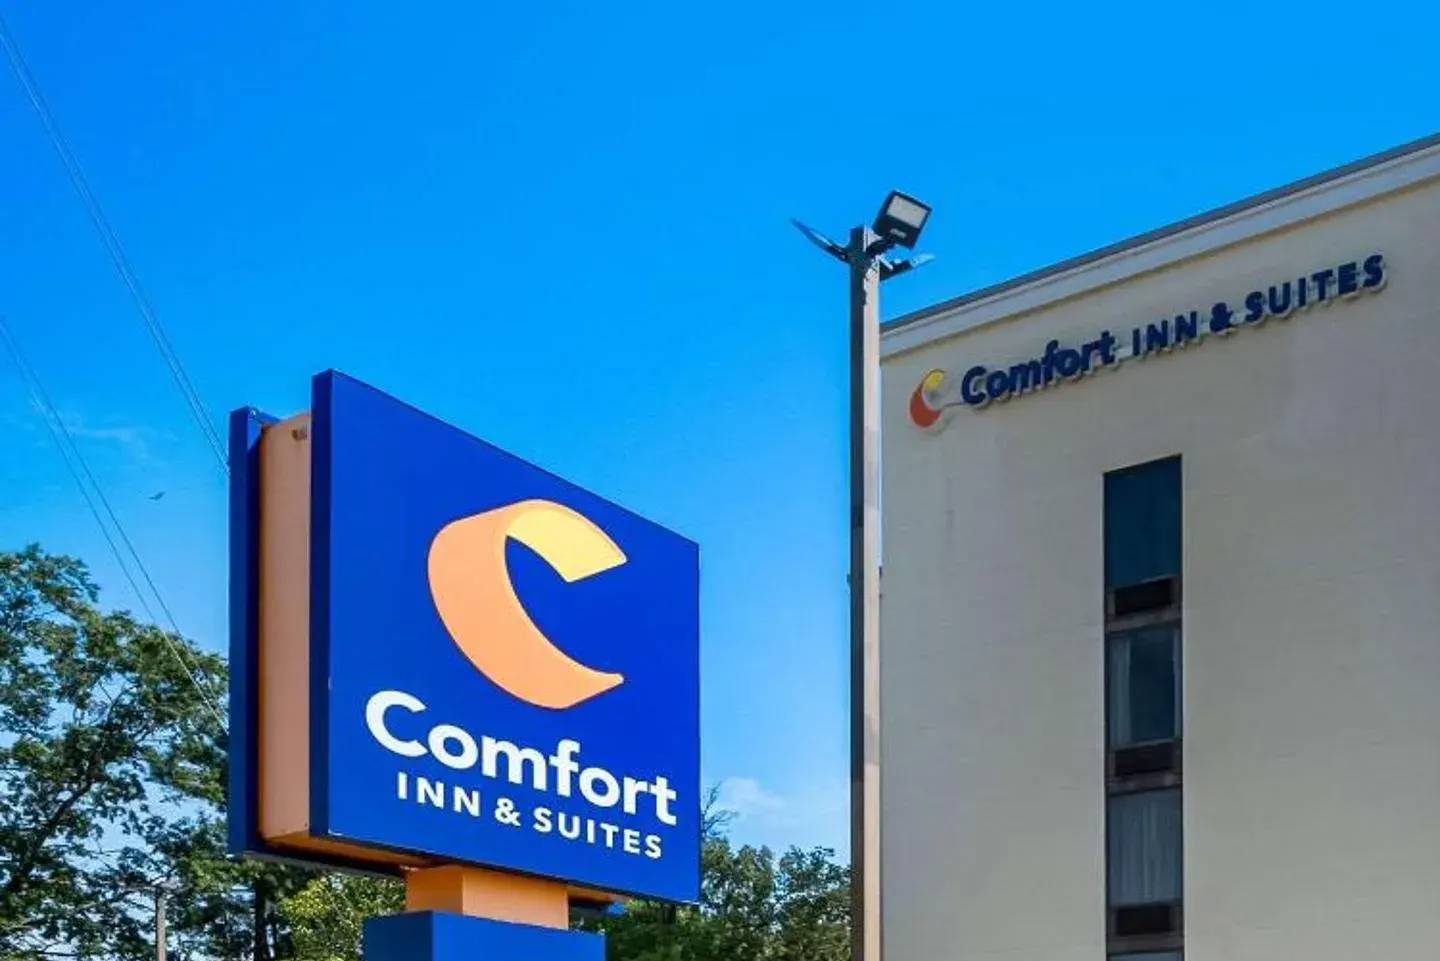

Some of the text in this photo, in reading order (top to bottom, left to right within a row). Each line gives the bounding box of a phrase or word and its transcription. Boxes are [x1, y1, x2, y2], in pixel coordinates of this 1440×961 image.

[961, 254, 1385, 405] Comfort INN & SUITES
[366, 690, 677, 825] Comfort
[398, 772, 661, 859] INN & SUITES
